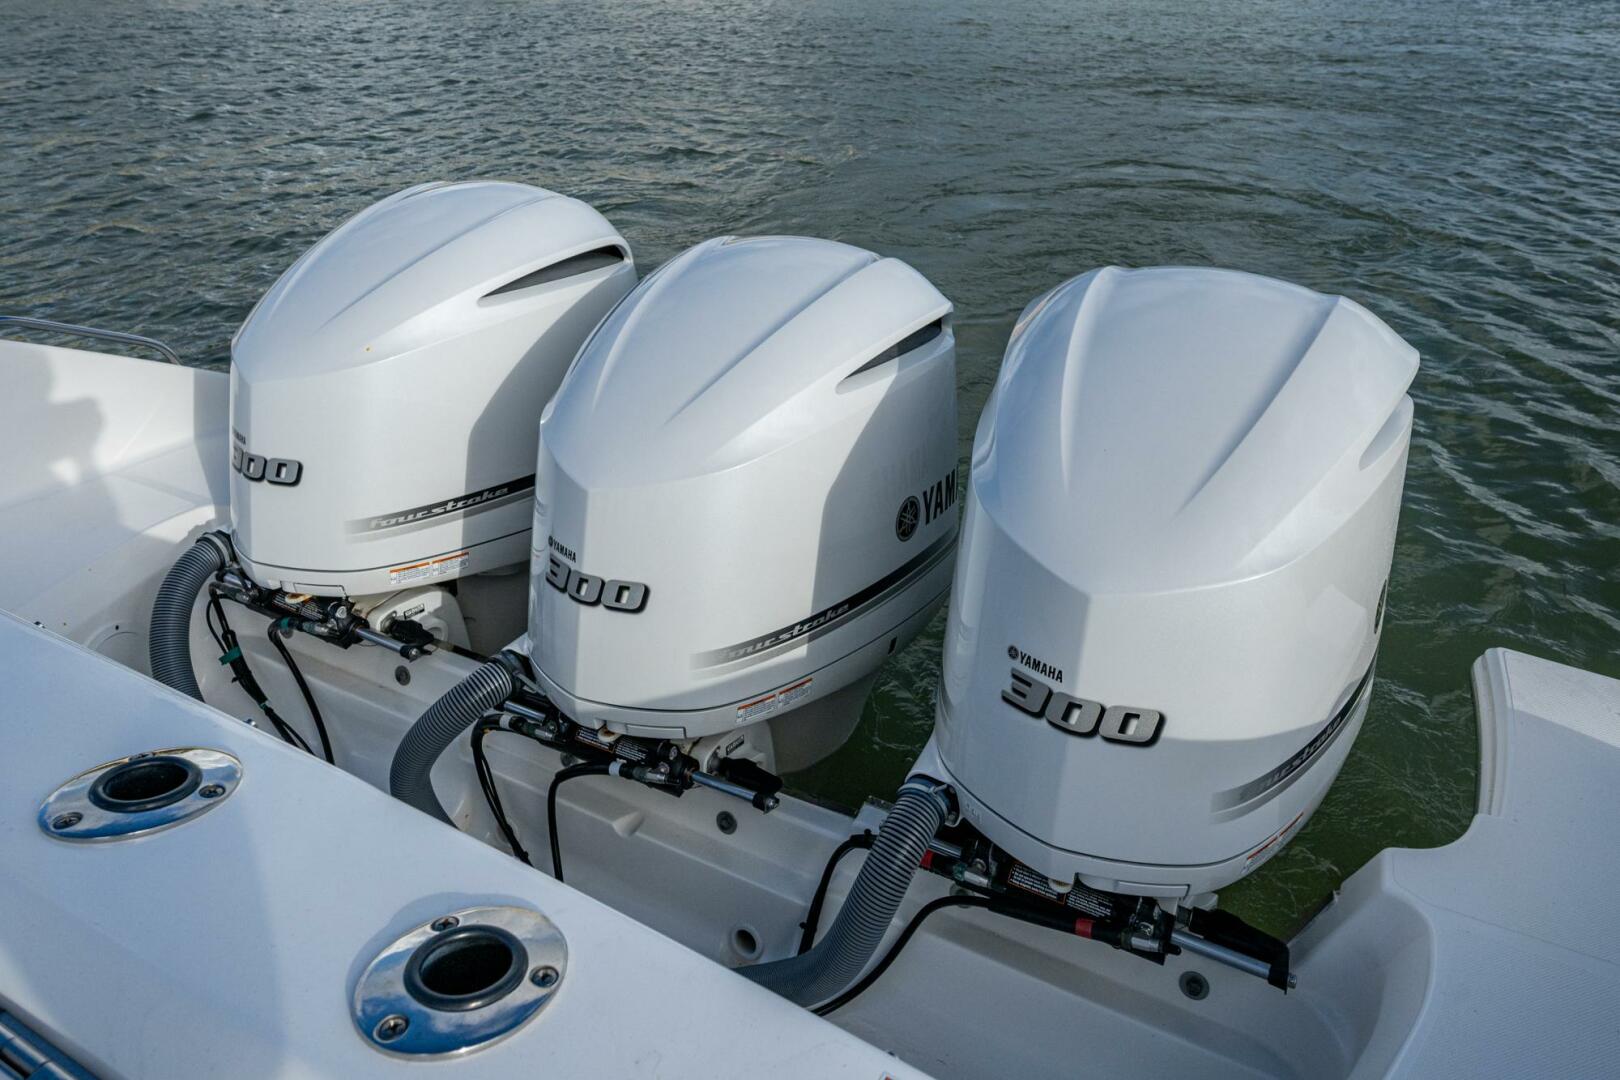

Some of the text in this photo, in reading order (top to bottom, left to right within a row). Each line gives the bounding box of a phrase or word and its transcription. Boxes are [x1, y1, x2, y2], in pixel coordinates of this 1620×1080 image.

[553, 539, 577, 563] YAMAHA
[545, 553, 651, 615] 300
[1019, 650, 1064, 684] YAMAHA
[1001, 667, 1168, 748] 300
